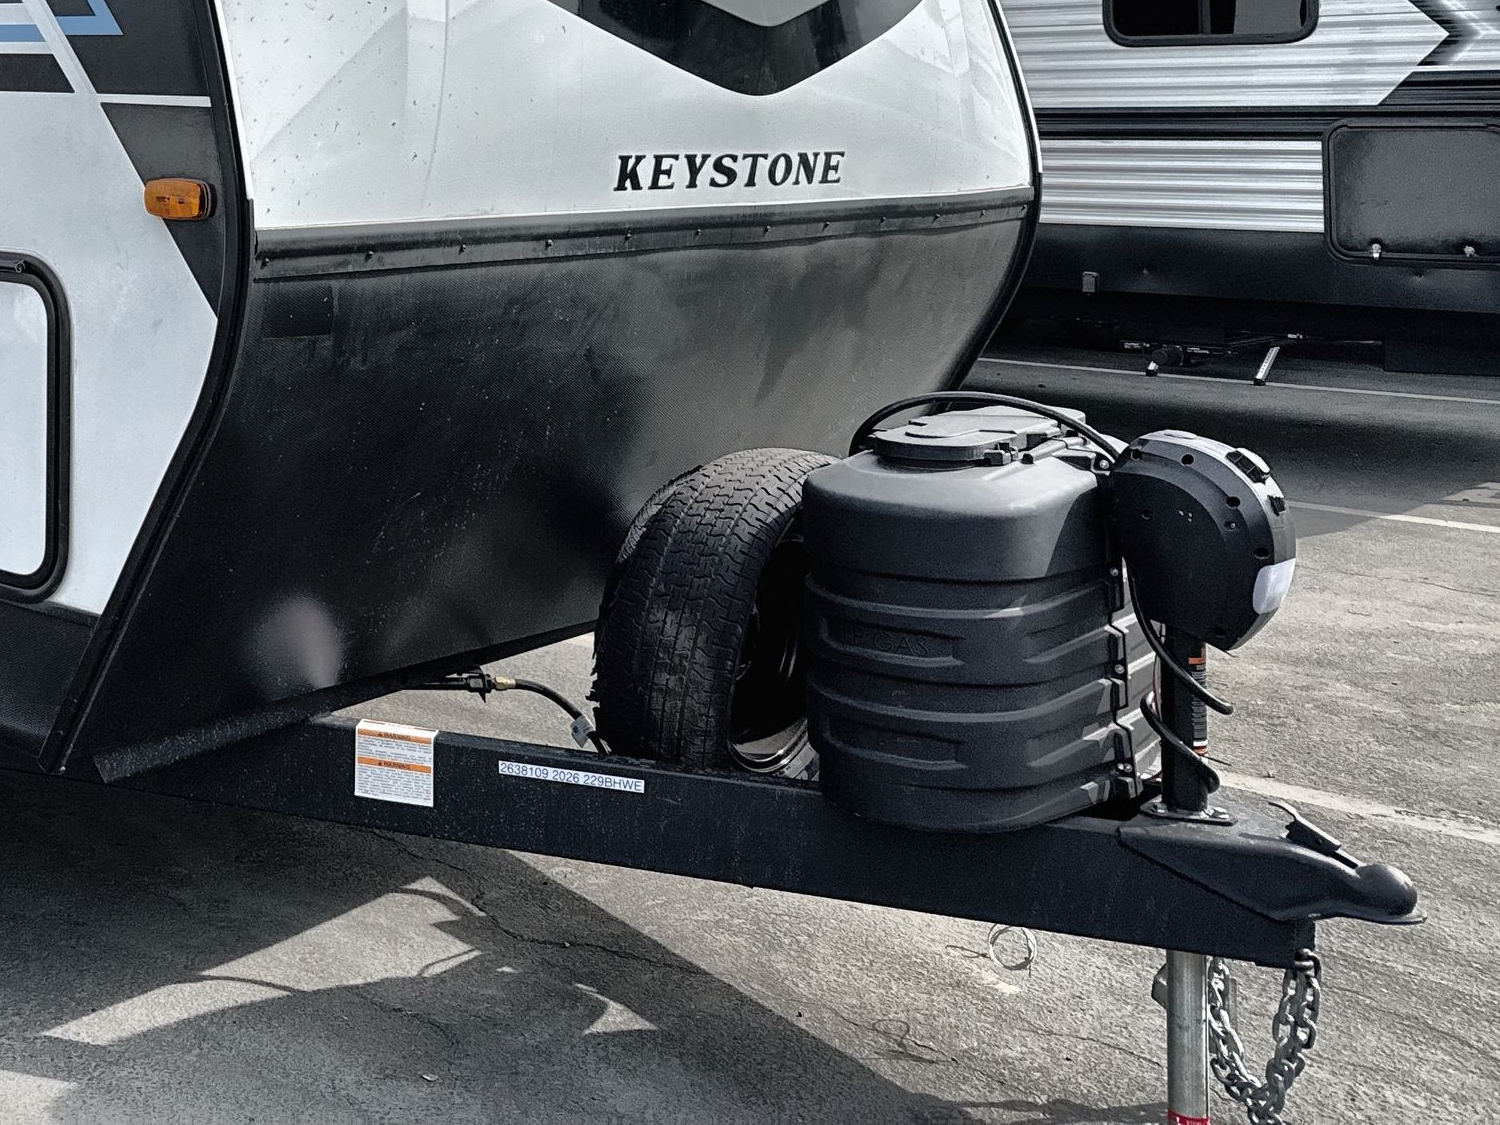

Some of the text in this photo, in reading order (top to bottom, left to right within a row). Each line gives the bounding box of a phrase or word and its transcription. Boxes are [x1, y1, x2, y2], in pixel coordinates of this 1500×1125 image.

[613, 151, 846, 192] KEYSTONE
[873, 631, 930, 658] GAS
[500, 762, 643, 792] 2638109 2026 229BHWE
